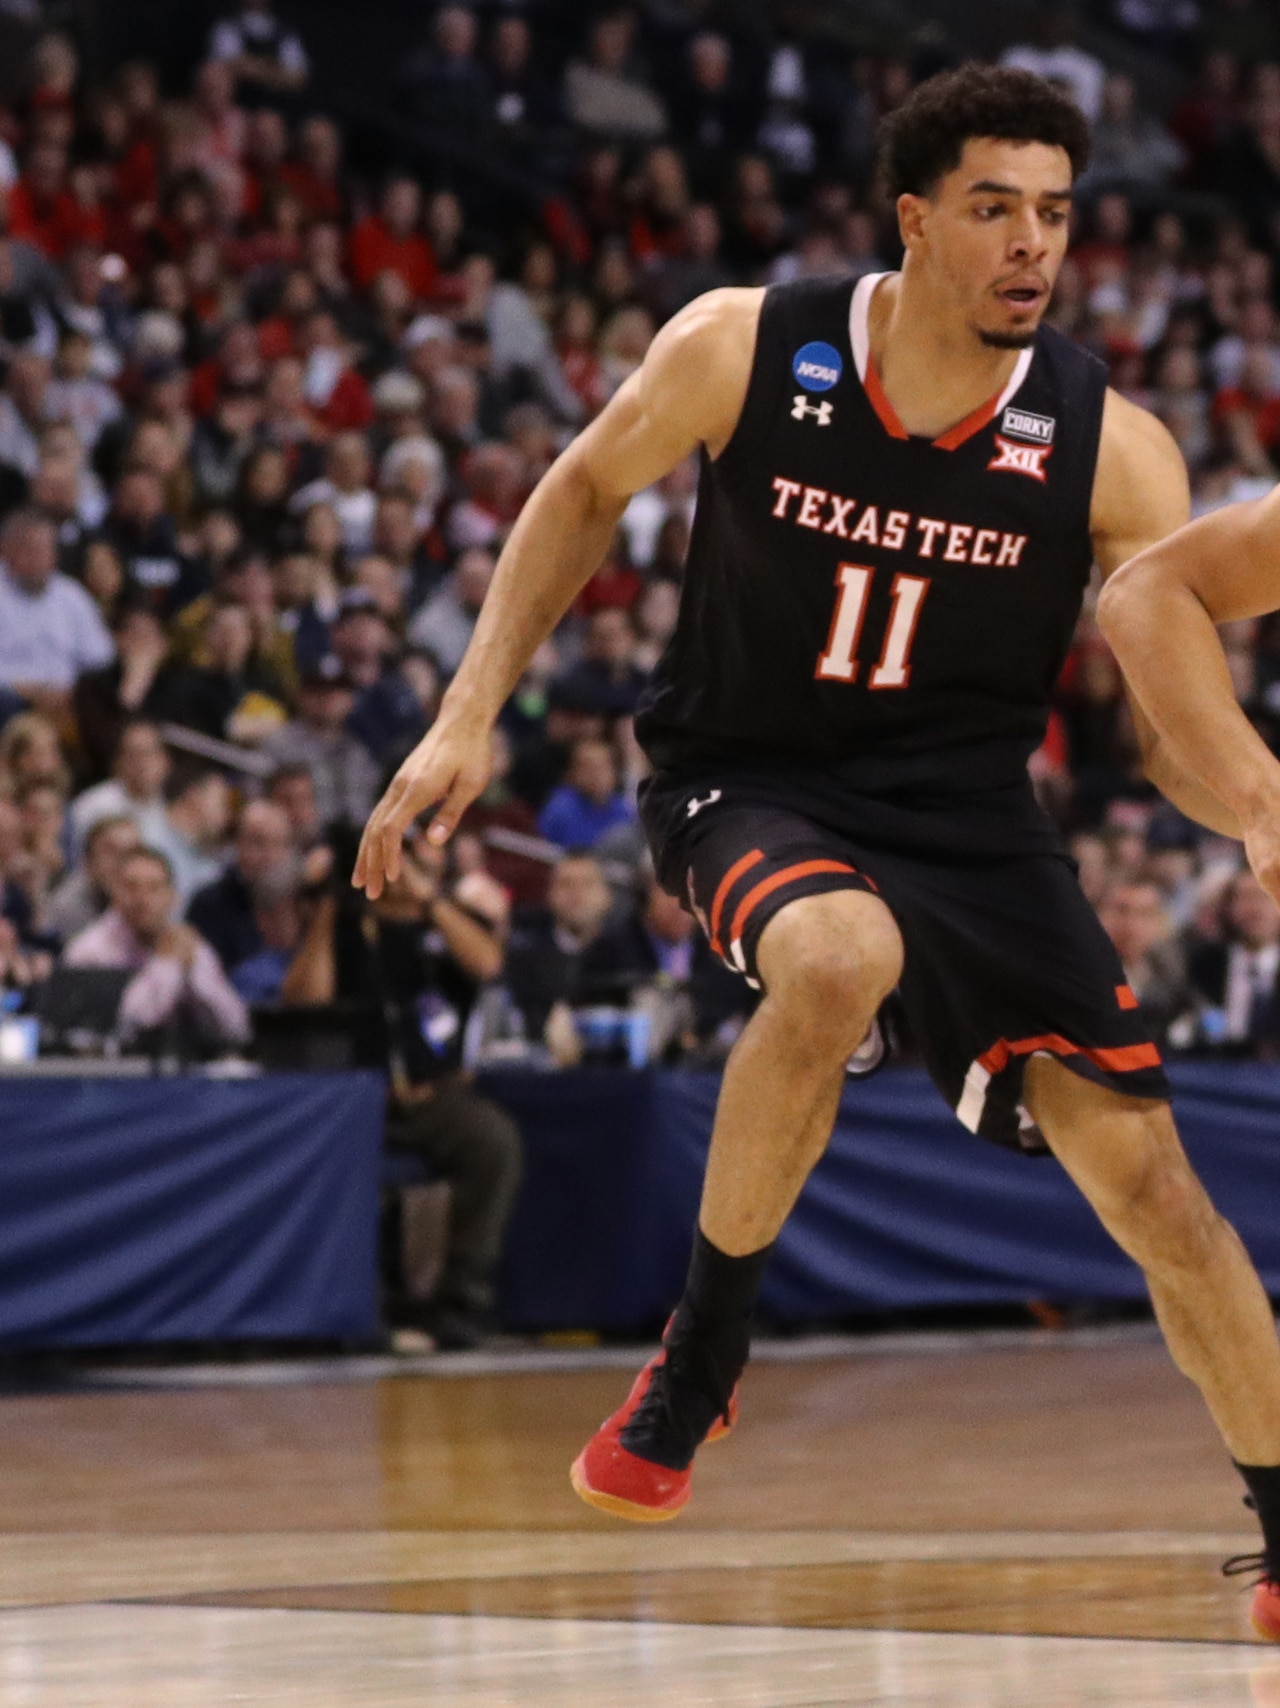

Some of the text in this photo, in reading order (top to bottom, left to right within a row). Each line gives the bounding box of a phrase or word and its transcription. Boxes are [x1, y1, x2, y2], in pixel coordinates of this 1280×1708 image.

[1006, 412, 1051, 438] CORKY
[771, 475, 1029, 567] TEXAS TECH
[814, 561, 932, 691] 11
